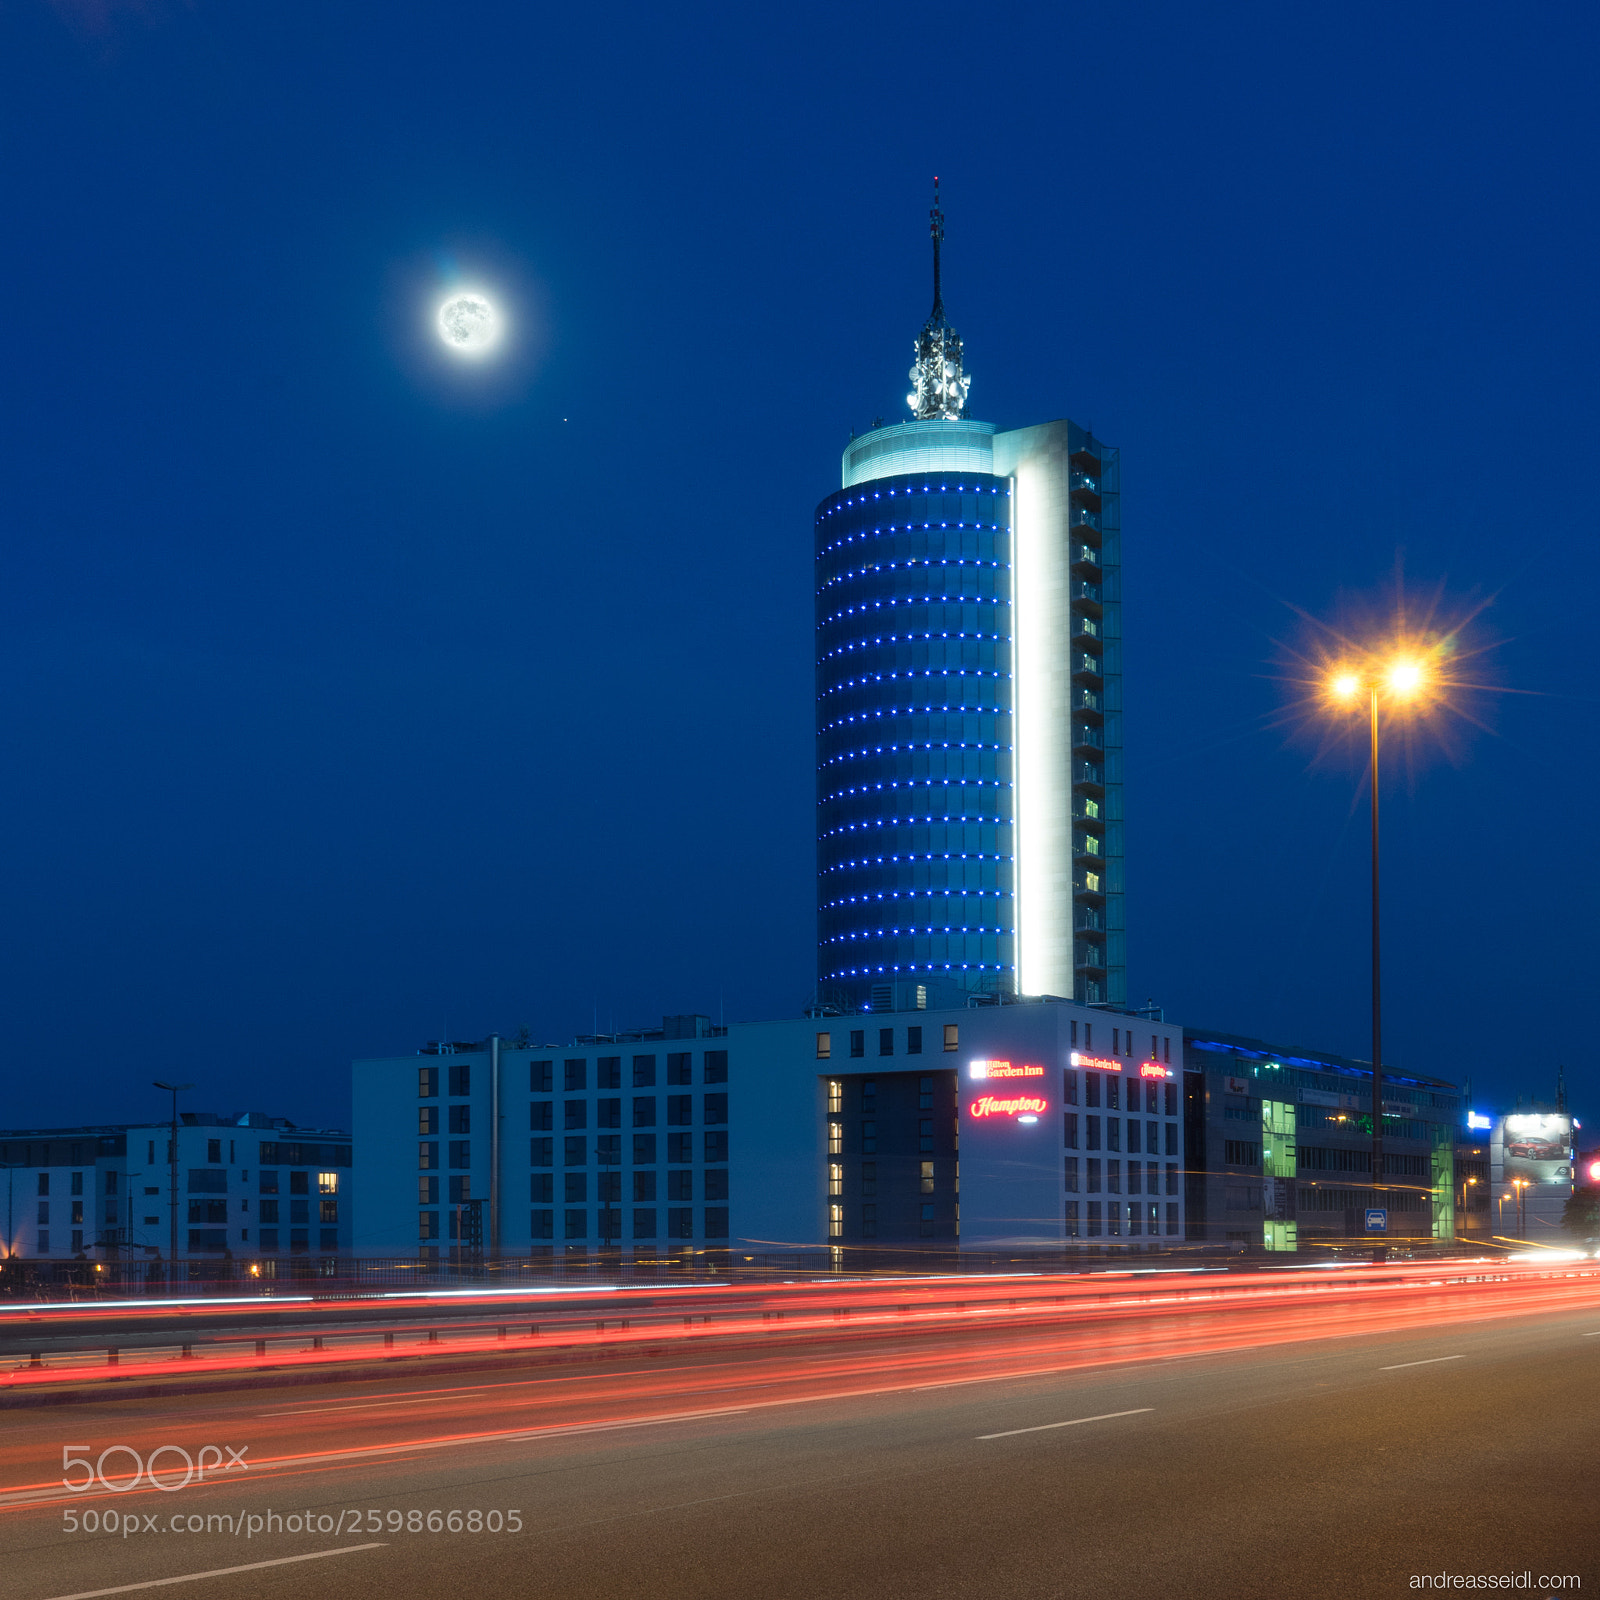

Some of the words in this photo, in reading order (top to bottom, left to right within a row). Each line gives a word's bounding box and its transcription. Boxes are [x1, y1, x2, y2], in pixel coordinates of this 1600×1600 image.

[986, 1060, 1010, 1068] Hilton
[1095, 1057, 1112, 1070] Garden
[1112, 1060, 1122, 1071] Inn
[1140, 1063, 1166, 1078] Hampton
[986, 1066, 1023, 1078] Garden
[1024, 1065, 1043, 1076] Inn
[970, 1096, 1047, 1117] Hampton
